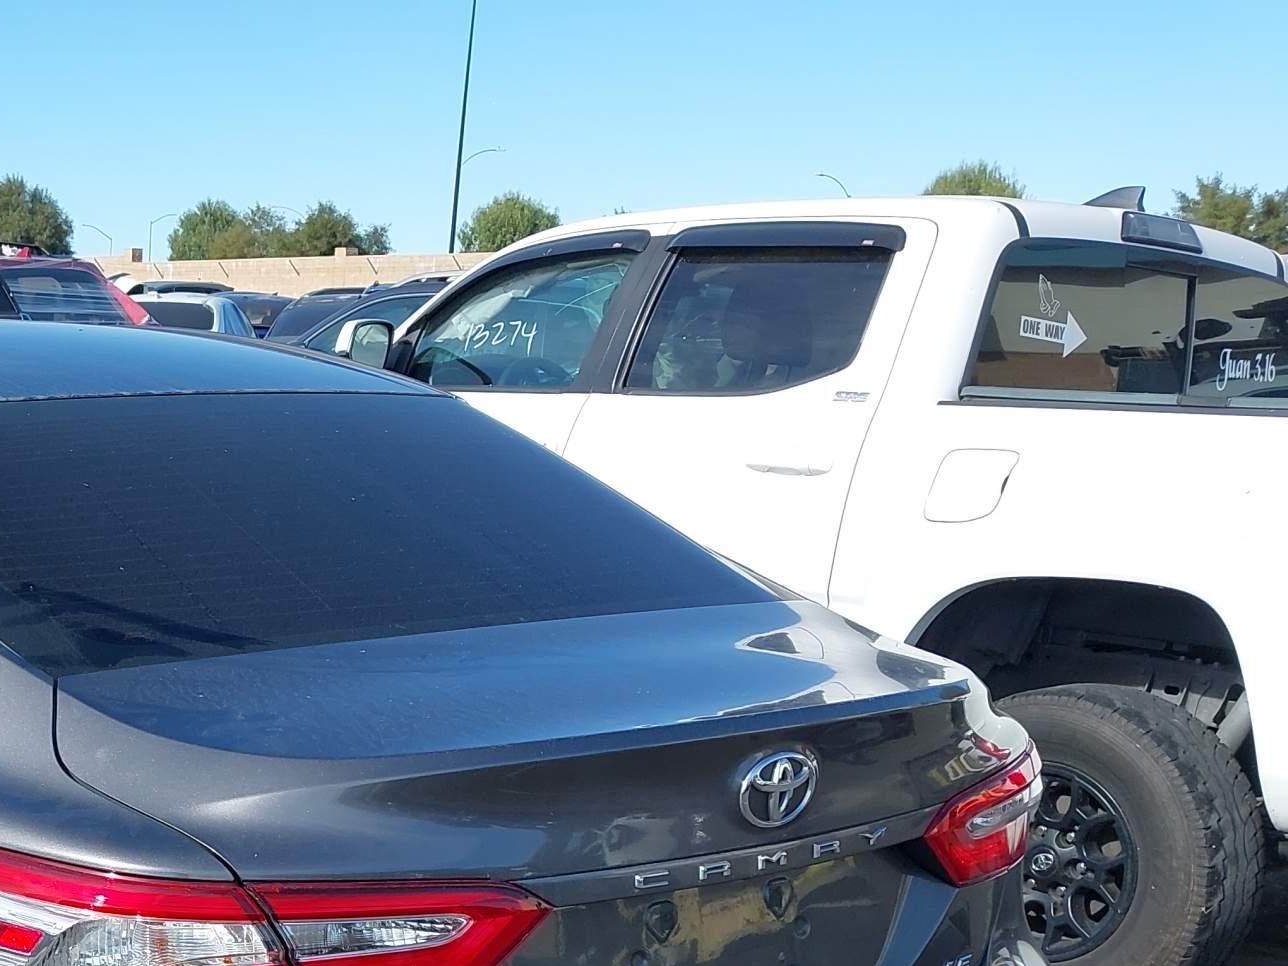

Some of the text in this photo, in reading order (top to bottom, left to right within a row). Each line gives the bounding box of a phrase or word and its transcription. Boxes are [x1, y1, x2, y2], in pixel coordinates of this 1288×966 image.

[464, 320, 538, 358] 13274
[1022, 319, 1066, 341] ONE WAY
[1216, 348, 1251, 391] Juan
[634, 826, 888, 889] CAMRY
